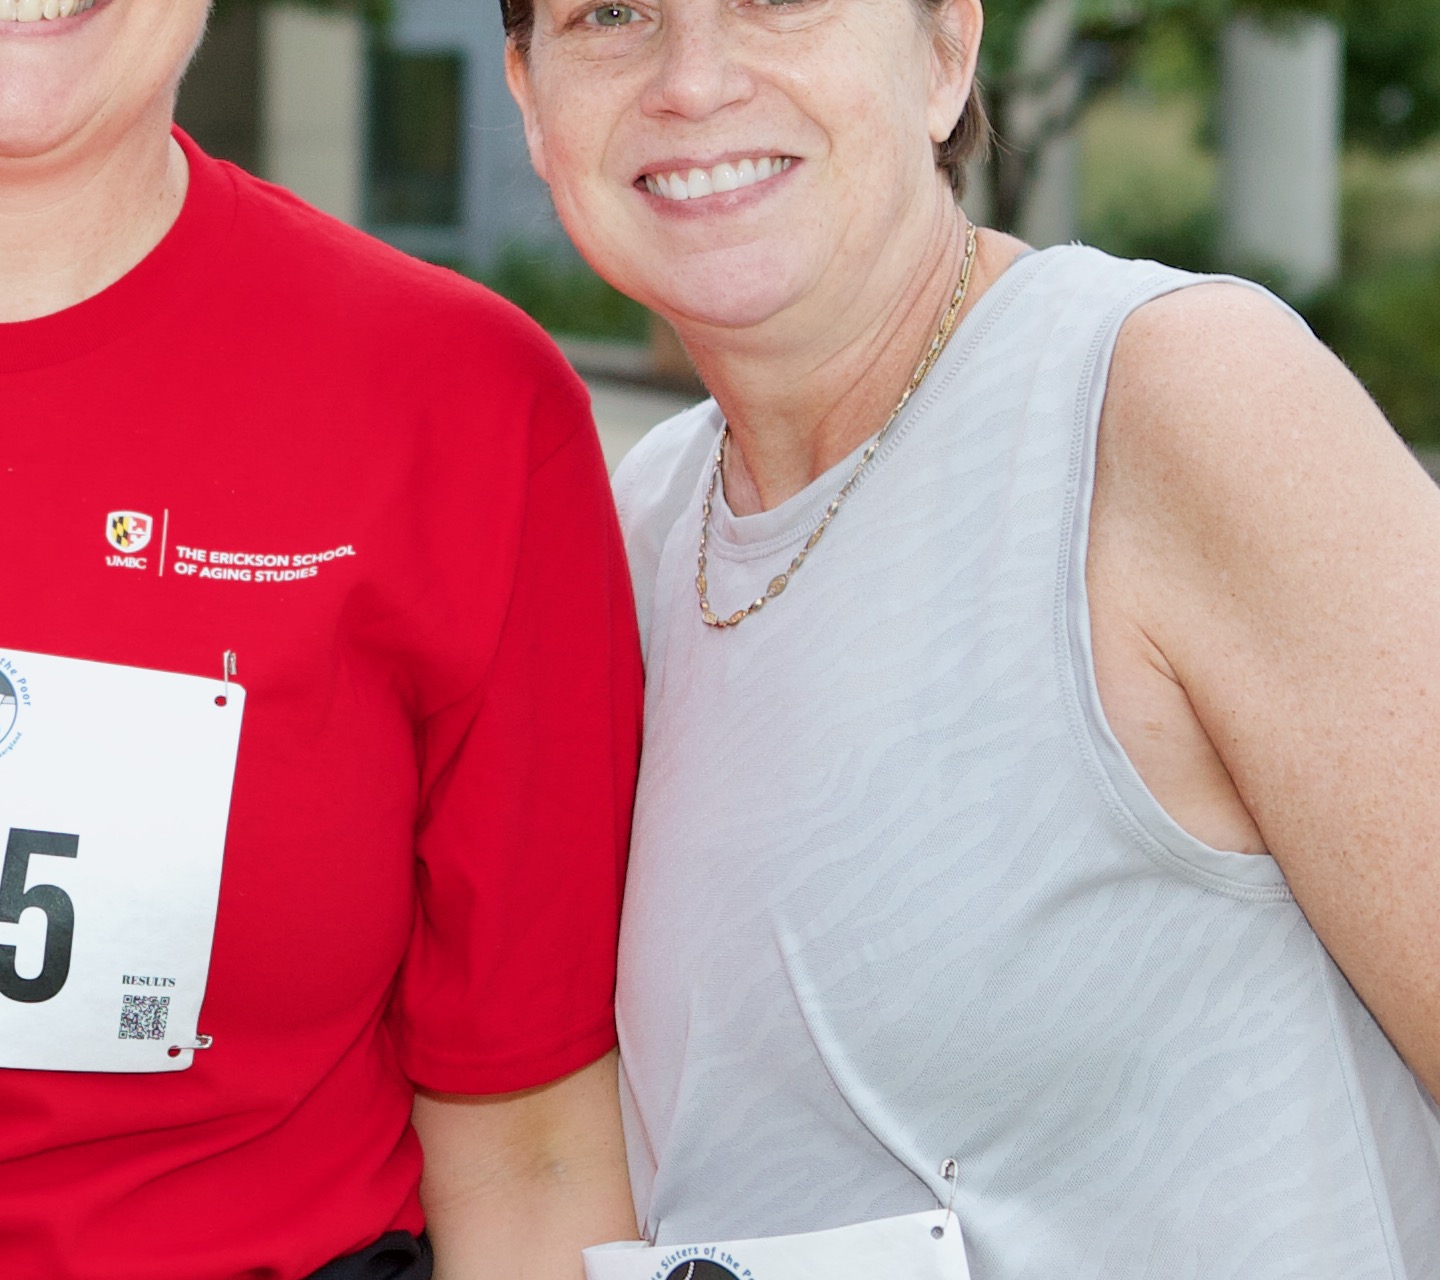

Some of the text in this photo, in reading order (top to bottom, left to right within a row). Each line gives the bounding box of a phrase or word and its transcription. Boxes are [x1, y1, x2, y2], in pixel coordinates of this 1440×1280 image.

[105, 555, 147, 570] UMBC
[176, 544, 356, 567] THE ERICKSON SCHOOL
[174, 562, 318, 582] OF AGING STUDIES
[0, 658, 17, 675] the
[16, 678, 31, 706] Poor
[122, 974, 176, 988] RESULTS
[660, 1246, 699, 1271] Sisters
[703, 1246, 717, 1259] of
[720, 1251, 741, 1270] the
